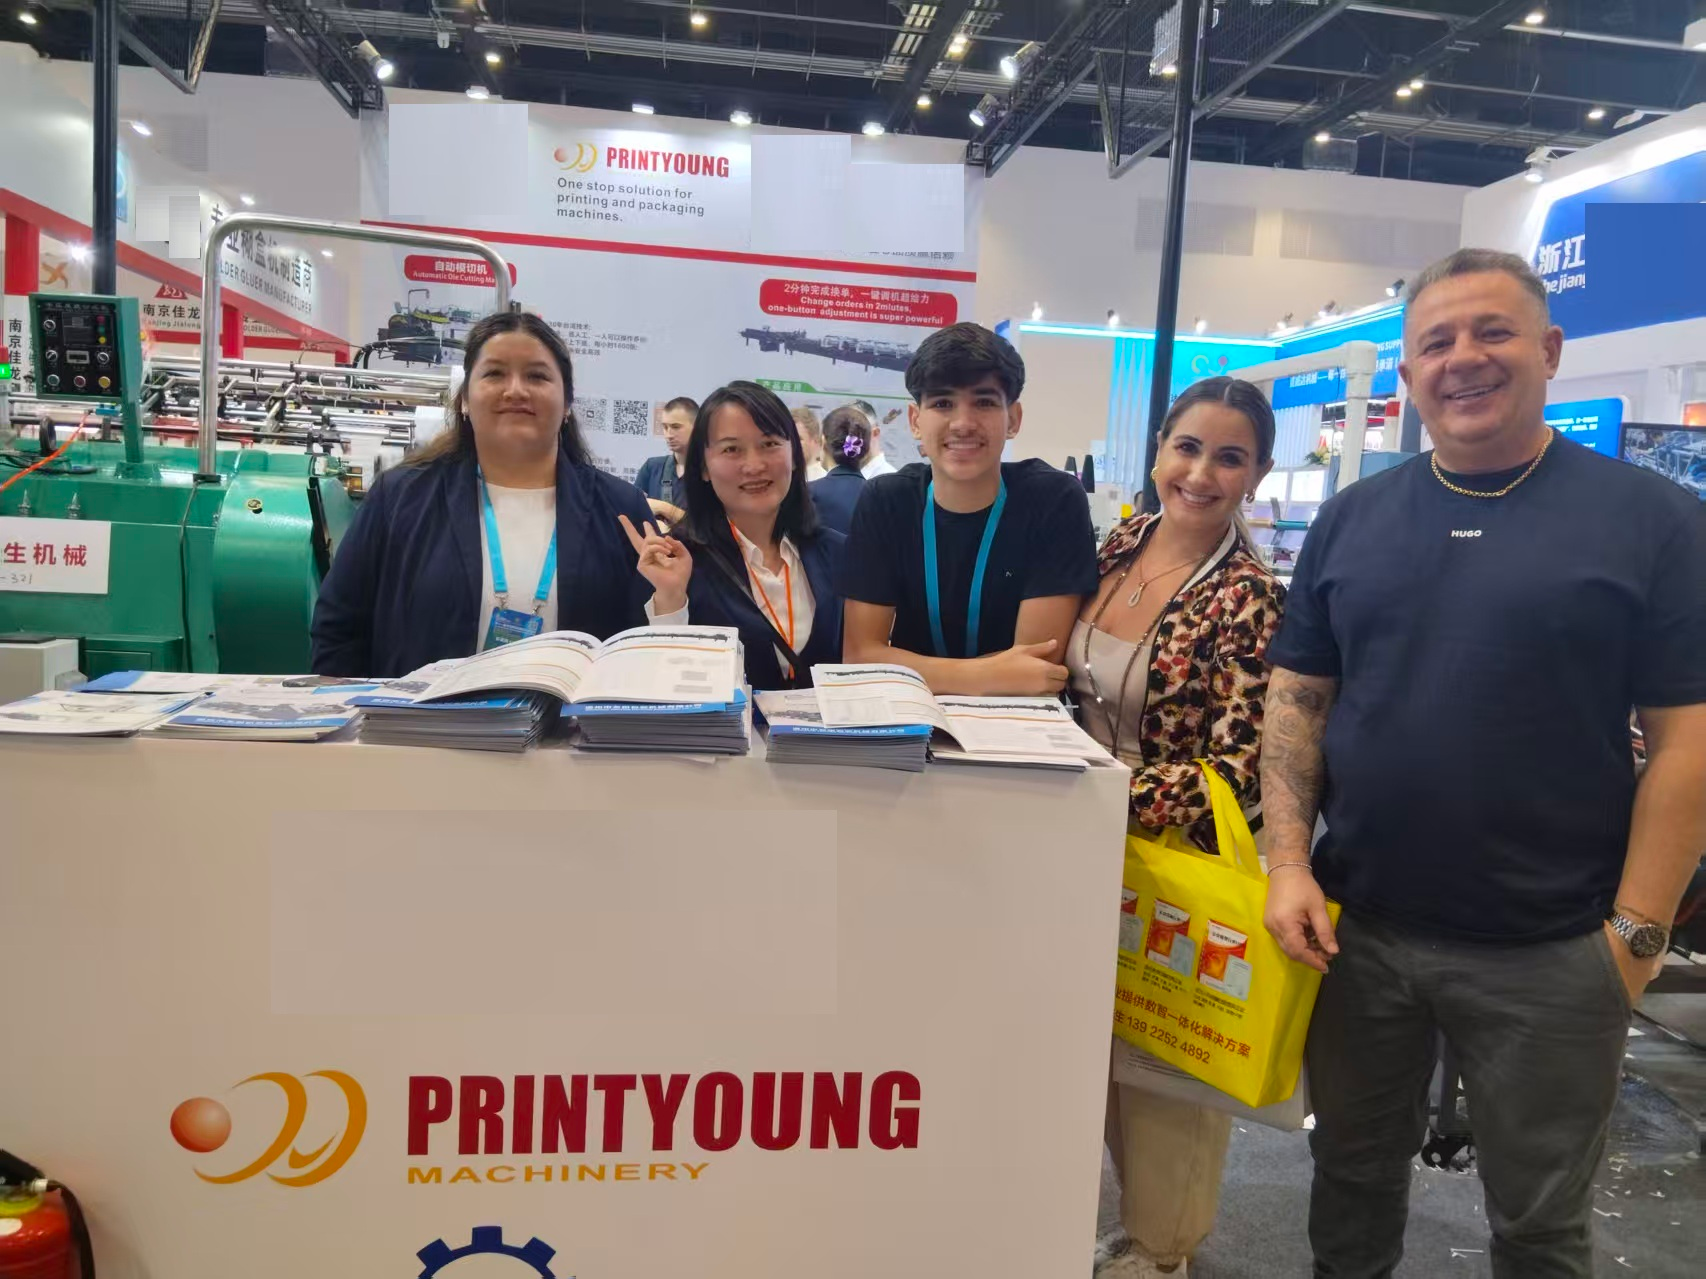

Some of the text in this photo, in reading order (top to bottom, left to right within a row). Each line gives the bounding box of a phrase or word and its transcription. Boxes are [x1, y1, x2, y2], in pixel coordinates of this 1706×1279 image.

[607, 146, 729, 178] PRINTYOUNG
[557, 177, 693, 199] One stop solution for
[557, 193, 705, 217] printing and packaging
[557, 208, 623, 222] machines.
[413, 270, 447, 280] Automatic
[485, 275, 495, 283] Ma
[434, 260, 488, 275] 自动模切机
[143, 303, 201, 319] 南京佳龙
[800, 296, 834, 307] Change
[835, 299, 864, 309] orders
[865, 301, 874, 309] in
[767, 304, 943, 324] one-button adjustment is super powerful
[1451, 529, 1482, 538] HUGO
[3, 542, 87, 567] 生机械
[1127, 1016, 1147, 1034] 139
[1149, 1024, 1177, 1049] 2252
[1180, 1041, 1211, 1065] 4892
[408, 1070, 921, 1156] PRINTYOUNG
[407, 1163, 710, 1185] MACHINERY
